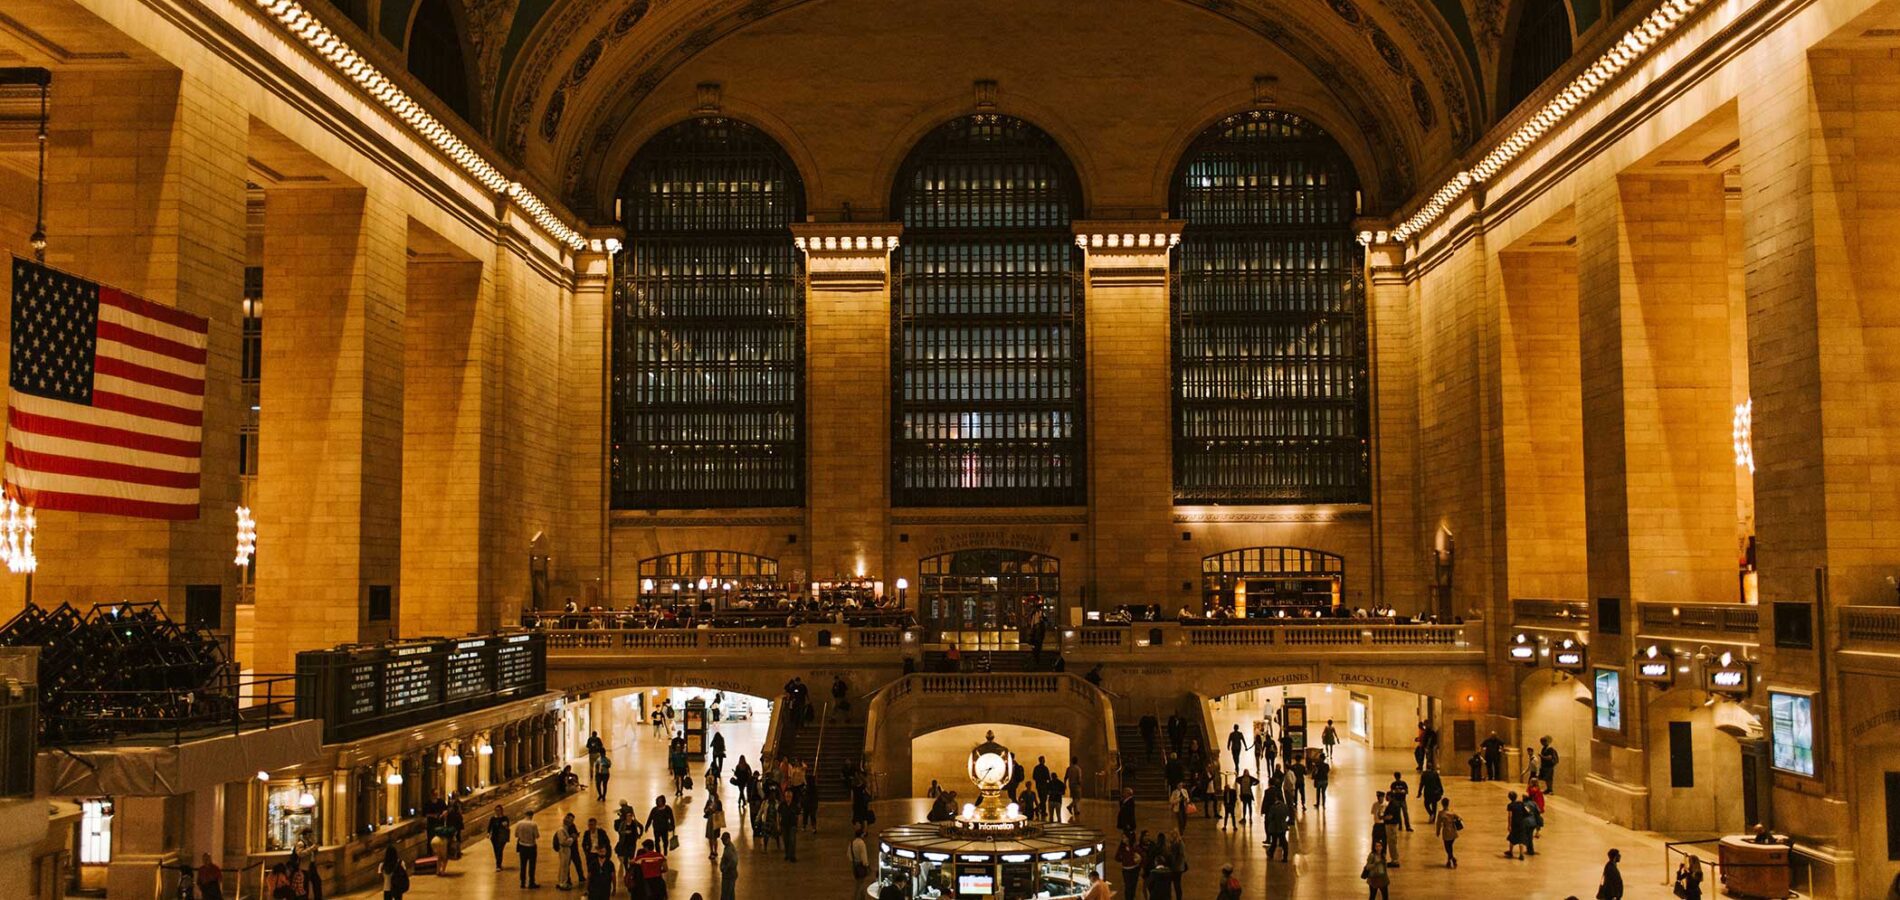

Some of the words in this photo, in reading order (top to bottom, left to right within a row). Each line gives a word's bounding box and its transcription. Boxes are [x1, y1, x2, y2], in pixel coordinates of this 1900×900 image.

[597, 676, 646, 687] MACHINES
[1230, 678, 1261, 690] TICKET
[1263, 673, 1310, 685] MACHINES
[1339, 673, 1375, 683] TRACKS
[1385, 678, 1399, 687] TO
[978, 822, 1015, 831] Information
